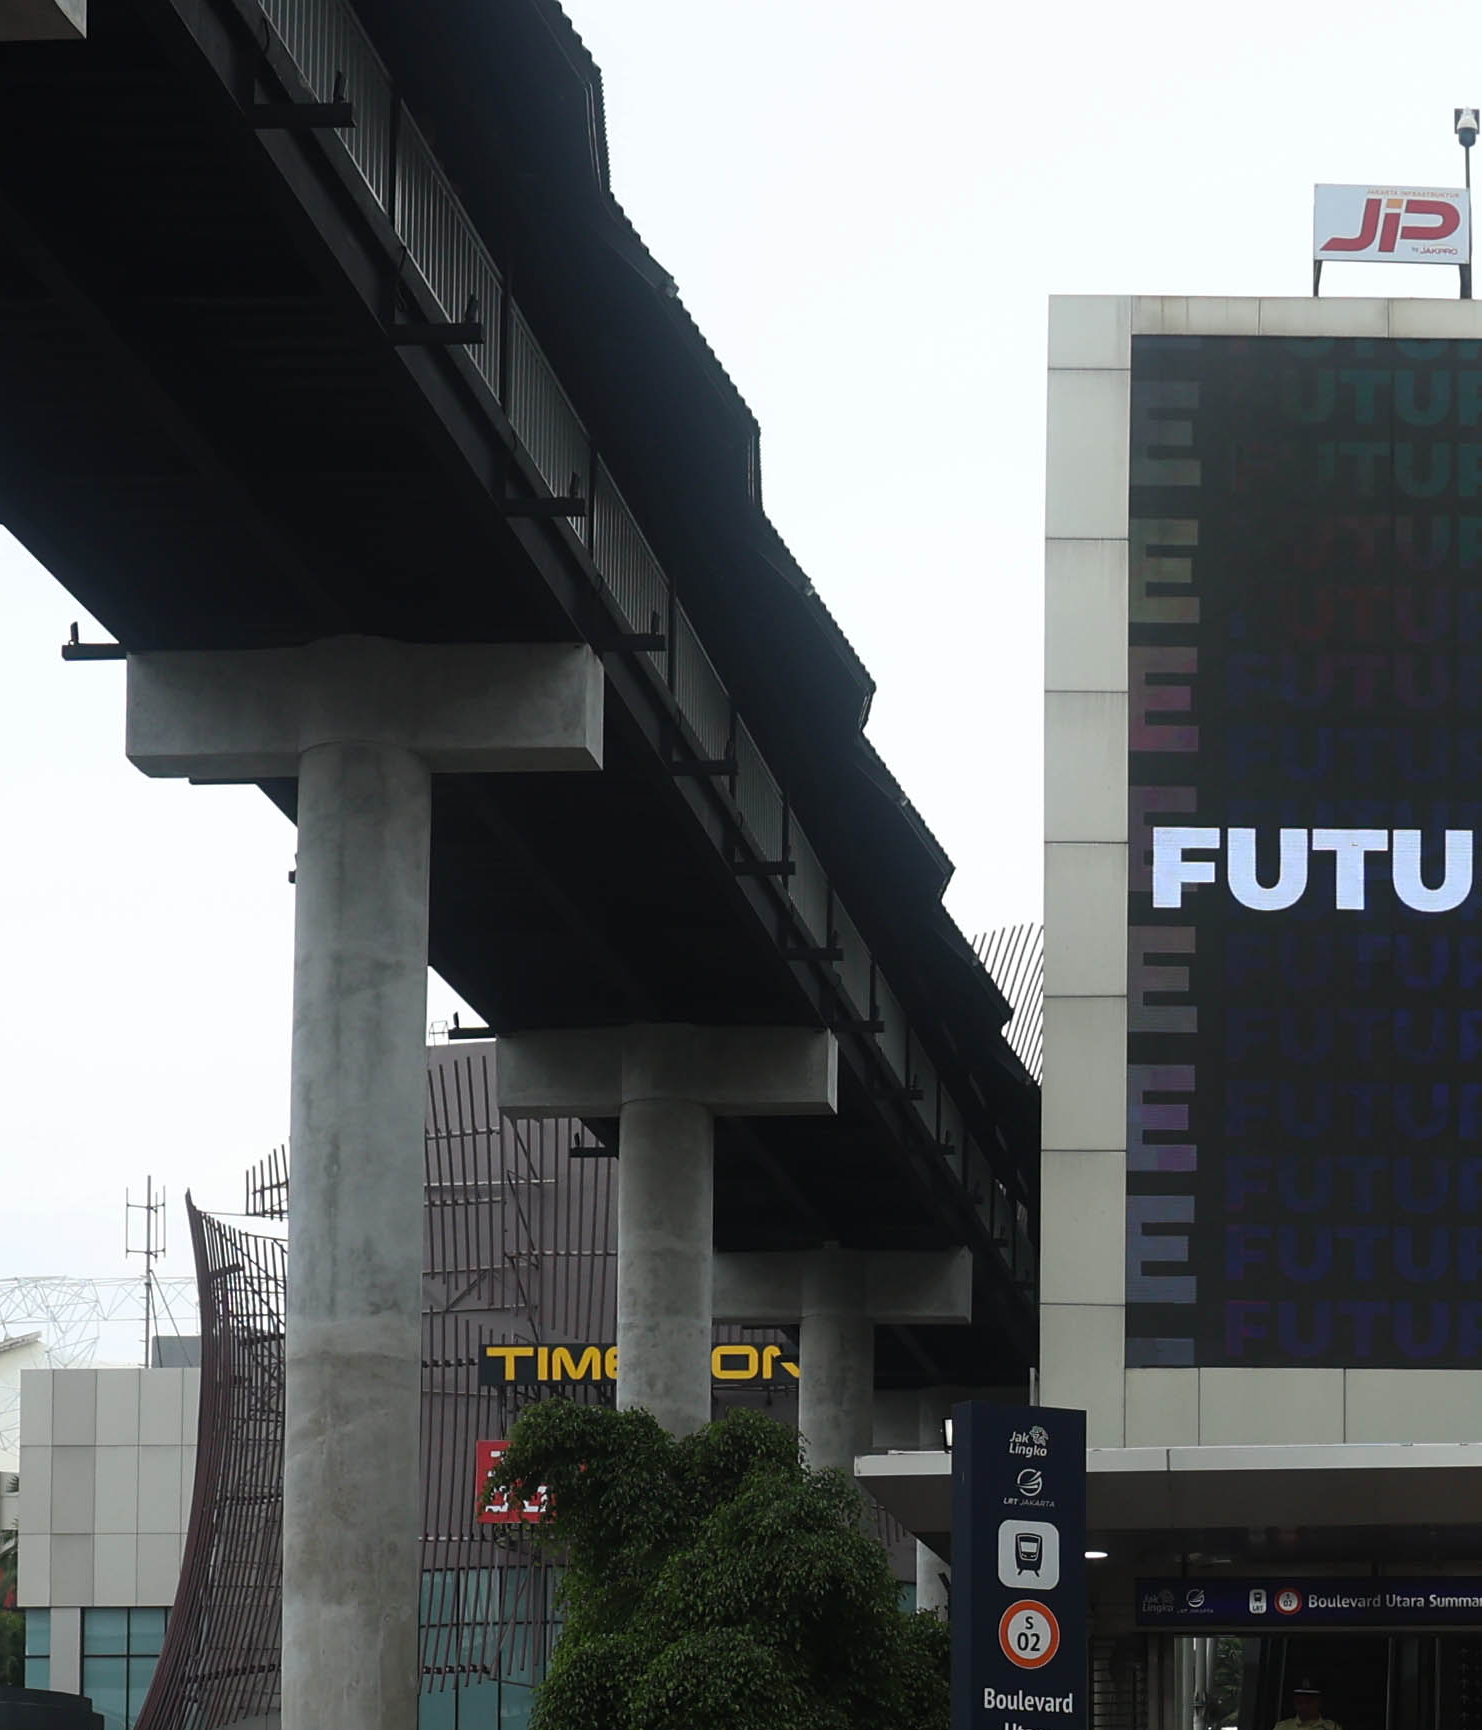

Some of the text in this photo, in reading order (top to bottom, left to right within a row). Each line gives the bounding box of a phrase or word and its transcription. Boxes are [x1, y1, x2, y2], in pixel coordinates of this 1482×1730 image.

[1009, 1431, 1030, 1444] Jak
[1009, 1442, 1048, 1458] Lingko
[1003, 1497, 1055, 1508] LRT JAKARTA
[1308, 1594, 1382, 1608] Boulevard
[1386, 1594, 1424, 1608] Utara
[1024, 1616, 1034, 1630] S
[1017, 1632, 1041, 1652] 02
[984, 1688, 1074, 1714] Boulevard
